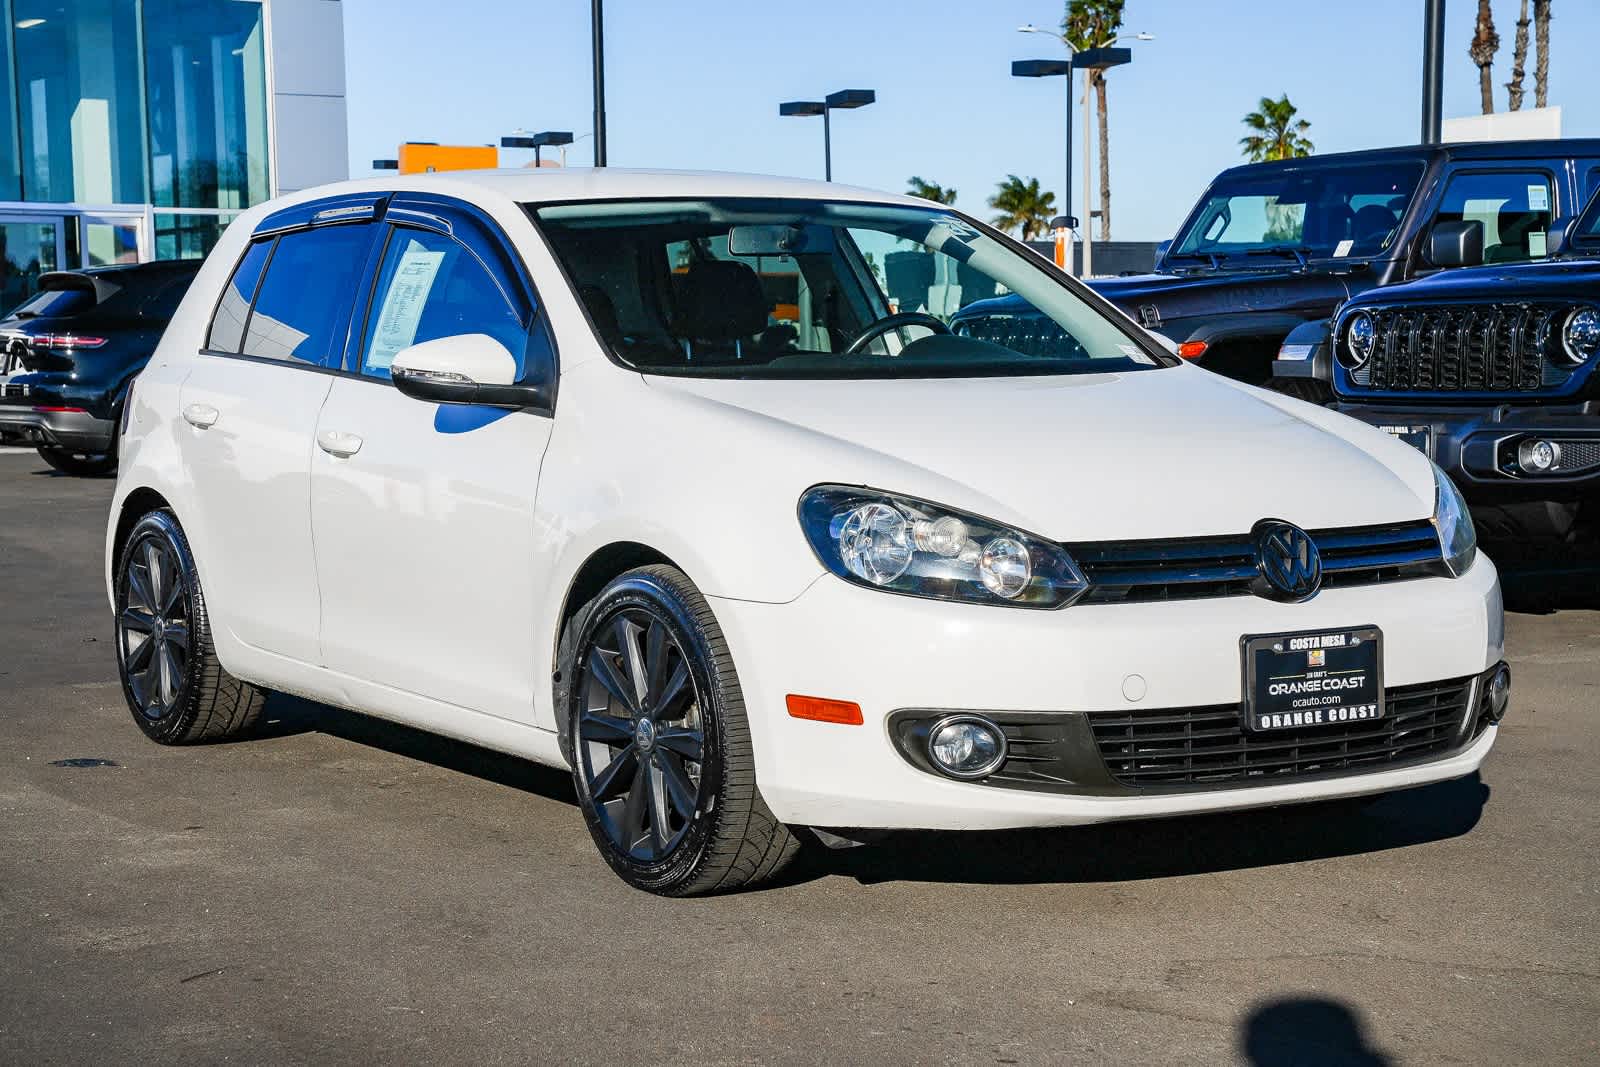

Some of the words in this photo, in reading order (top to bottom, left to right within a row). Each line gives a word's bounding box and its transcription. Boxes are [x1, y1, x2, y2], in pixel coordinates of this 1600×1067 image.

[1290, 636, 1320, 649] COSTA
[1321, 634, 1346, 647] MESA
[1268, 679, 1321, 695] ORANGE
[1322, 676, 1366, 690] COAST
[1292, 695, 1341, 708] ocauto.com
[1261, 710, 1322, 728] ORANGE
[1329, 705, 1377, 721] COAST
